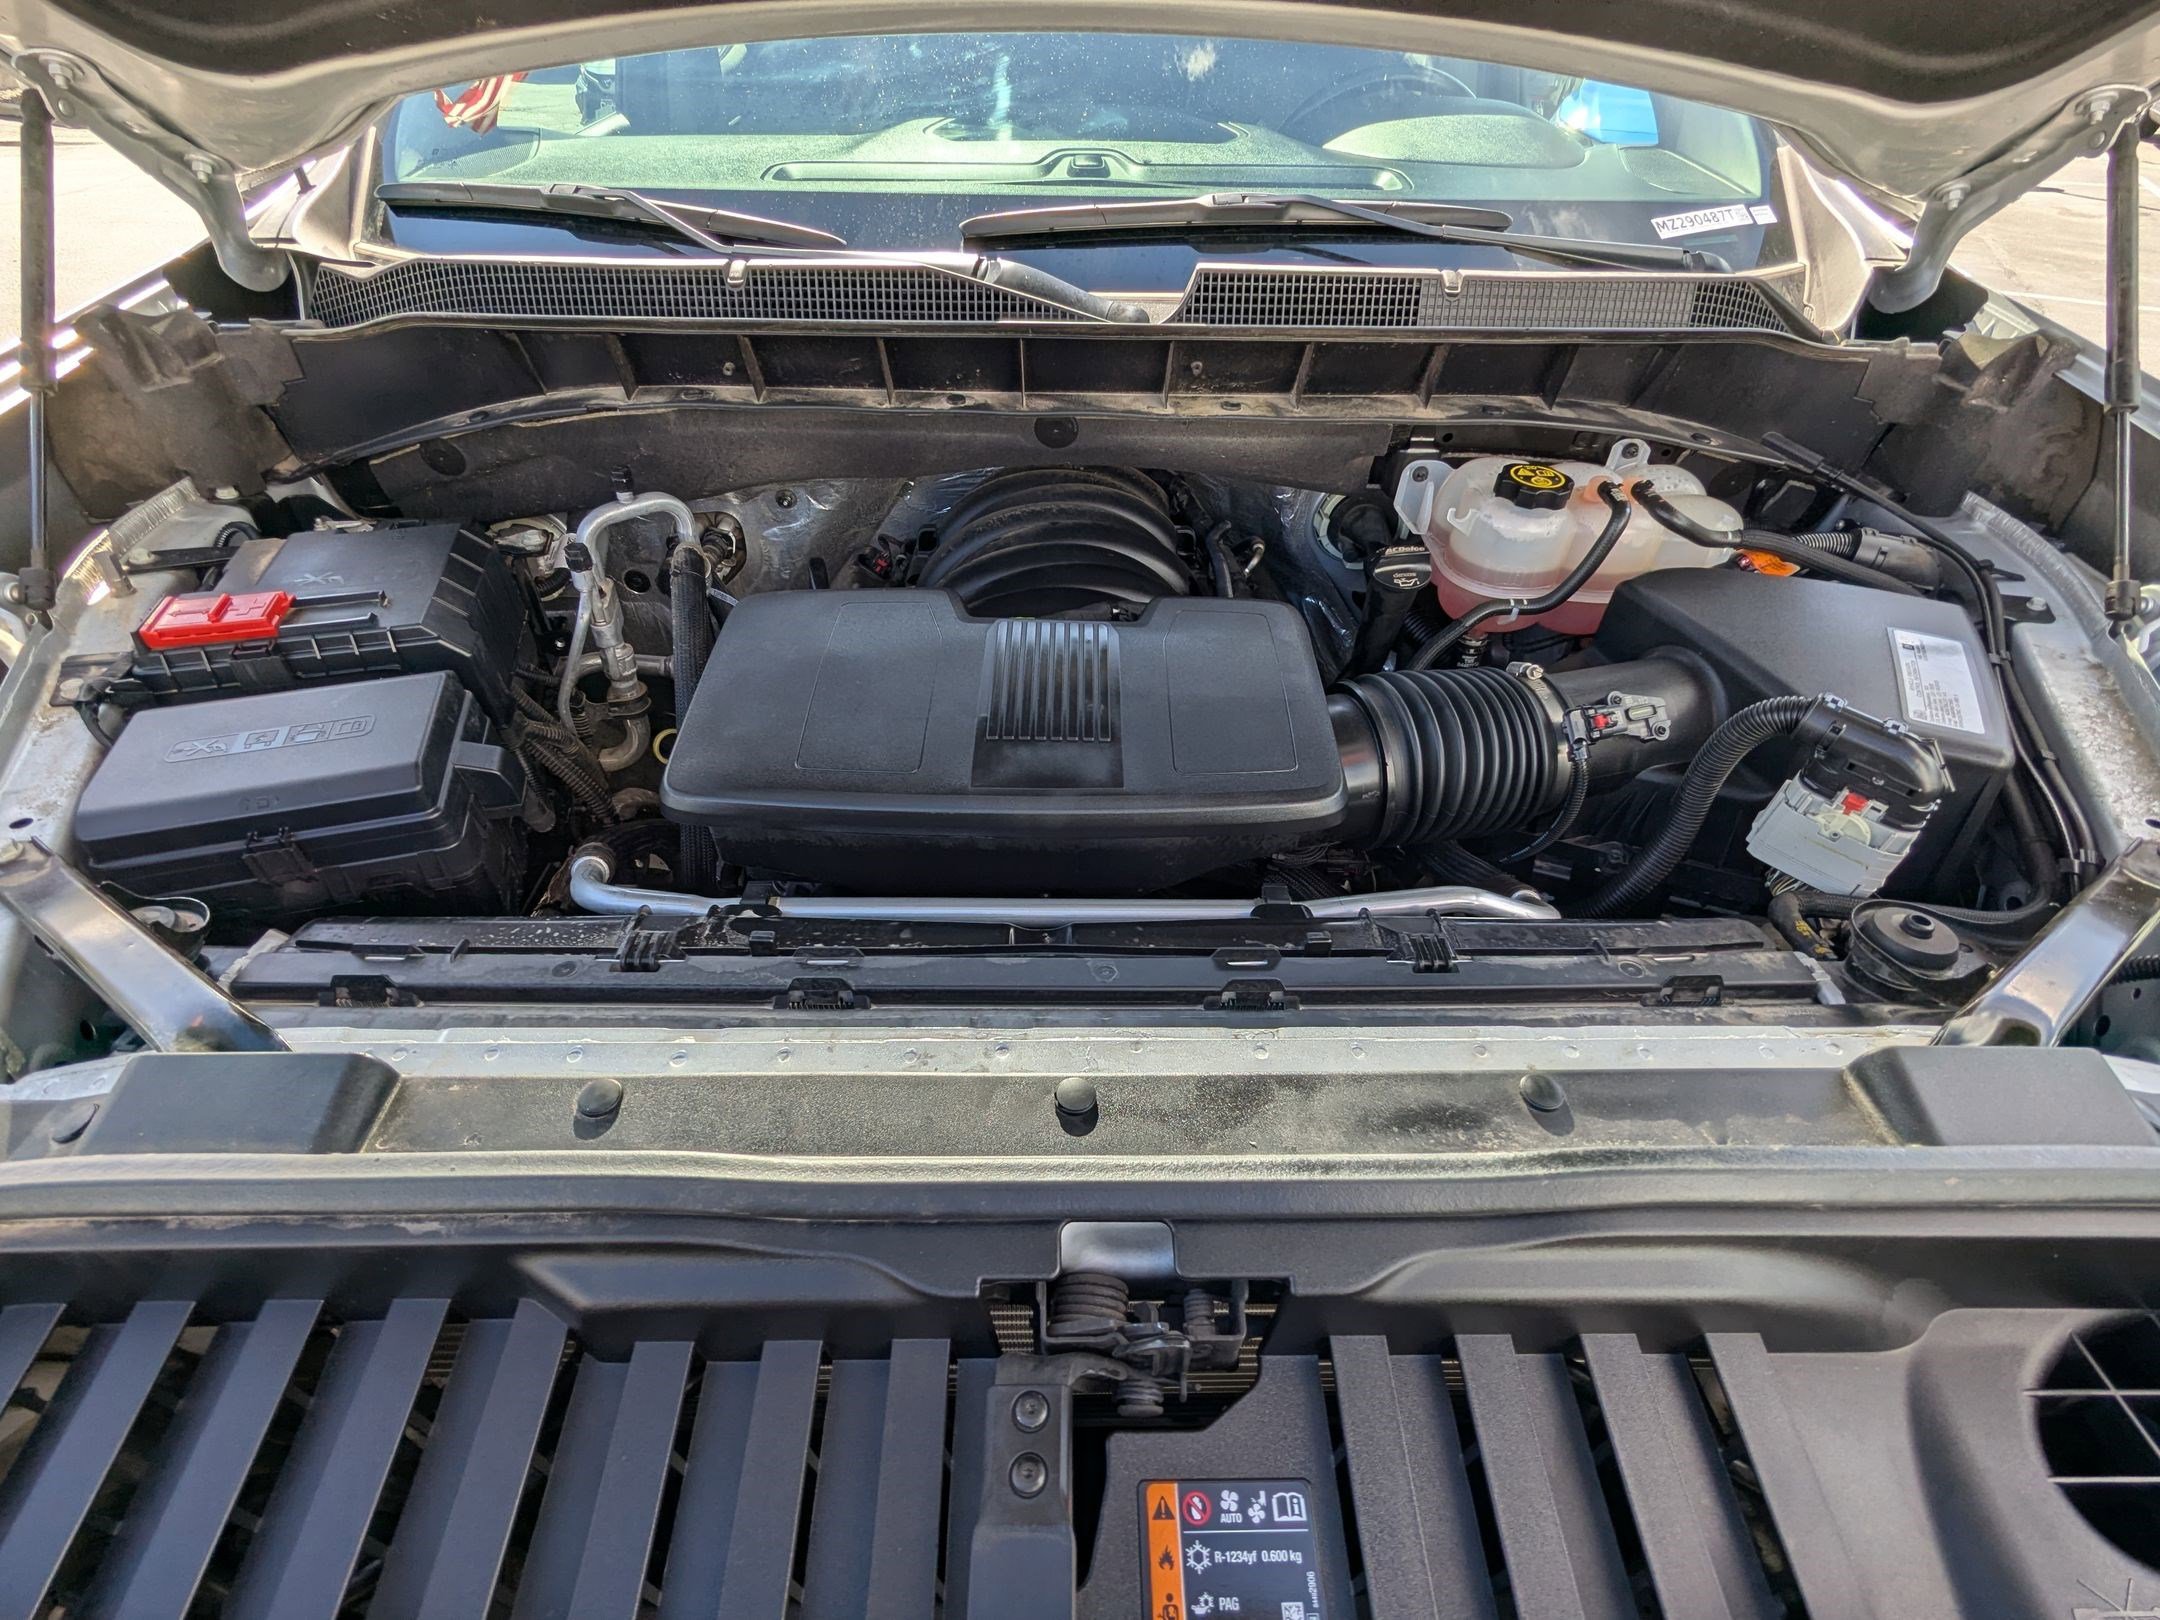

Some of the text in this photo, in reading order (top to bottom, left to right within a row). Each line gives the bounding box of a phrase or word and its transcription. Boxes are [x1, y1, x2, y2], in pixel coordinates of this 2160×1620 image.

[1655, 209, 1734, 232] MZ290487T
[1220, 1513, 1242, 1523] AUTO
[1214, 1550, 1303, 1565] R-1234yf 0.600 kg
[1219, 1597, 1240, 1611] PAG
